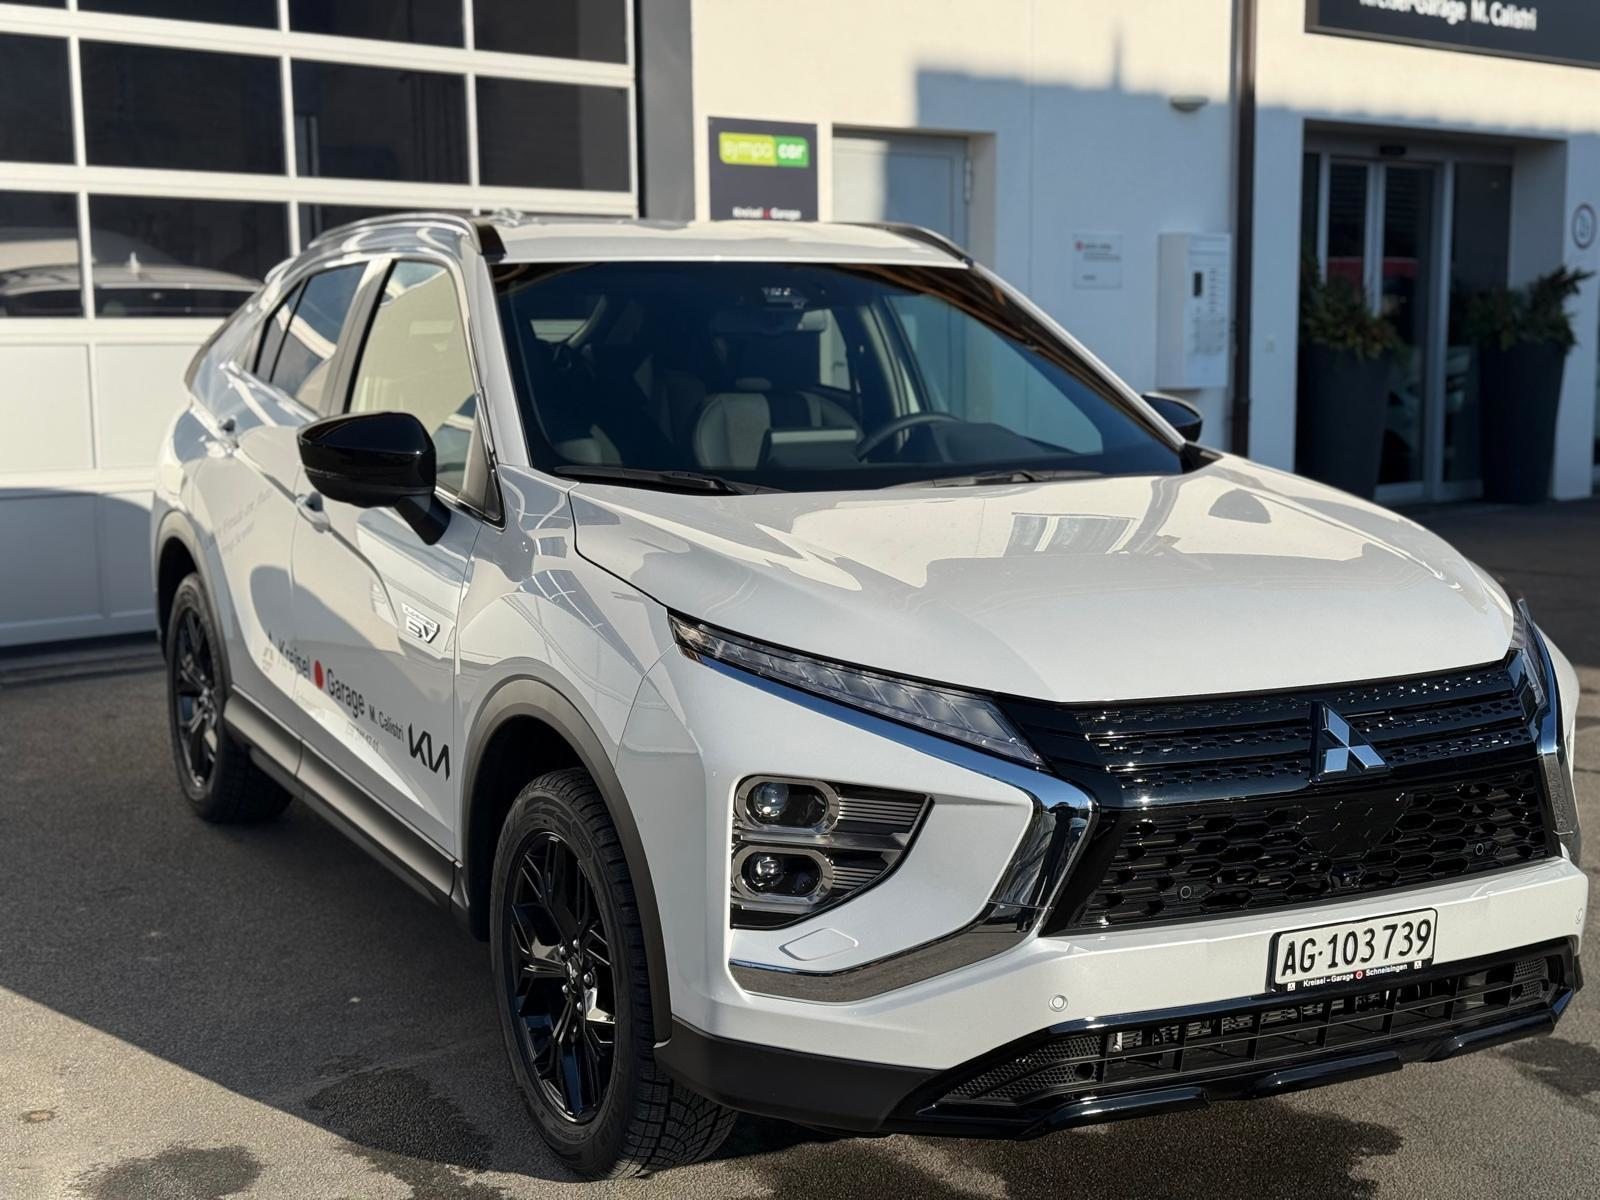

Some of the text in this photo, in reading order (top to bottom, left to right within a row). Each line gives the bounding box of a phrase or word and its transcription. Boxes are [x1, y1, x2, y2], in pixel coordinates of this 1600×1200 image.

[1489, 1, 1537, 31] Calistri
[327, 669, 365, 718] Garage
[379, 711, 404, 742] Calistri
[1366, 963, 1408, 977] Schneisingen
